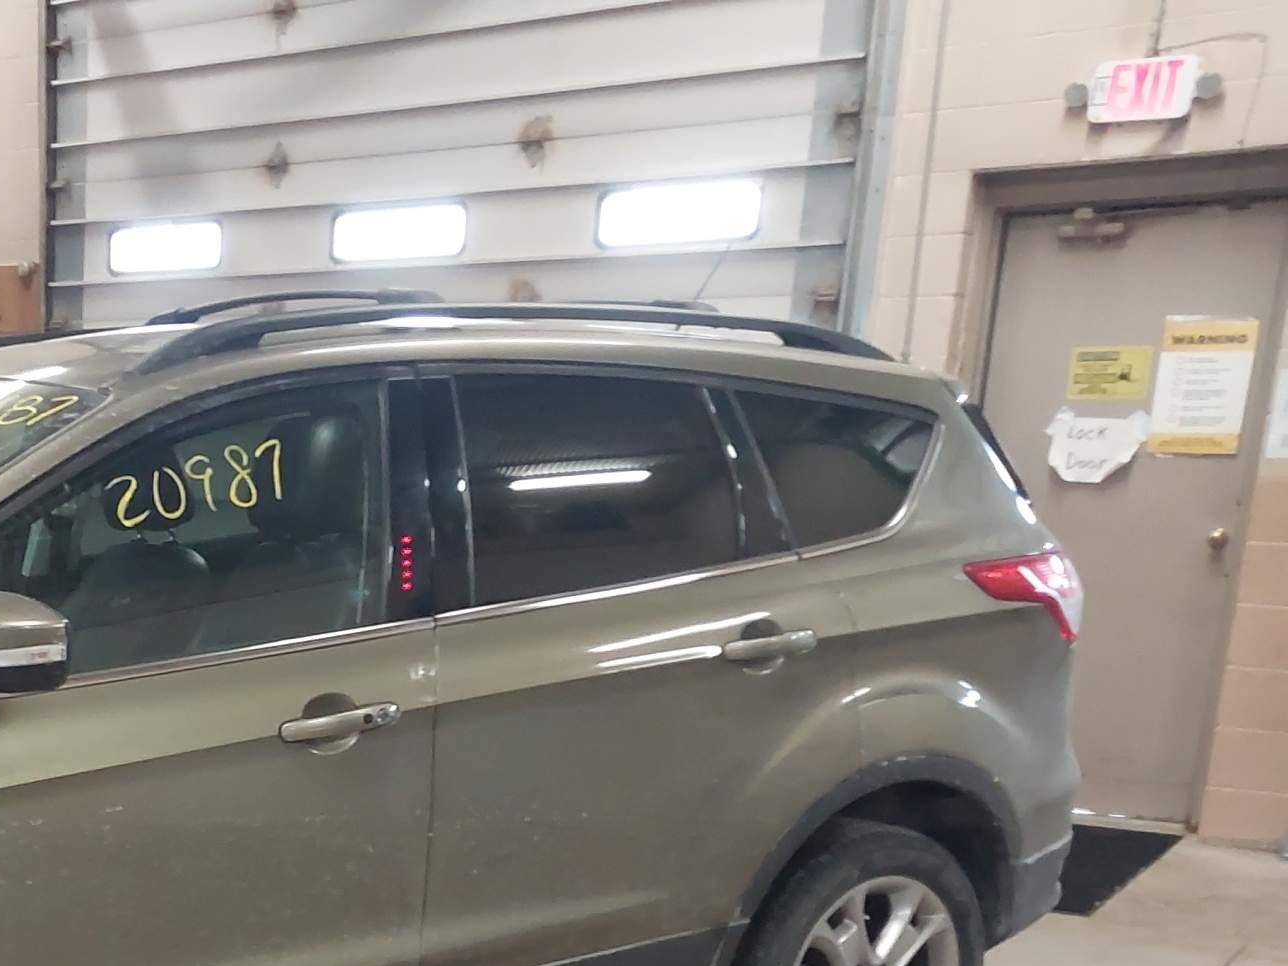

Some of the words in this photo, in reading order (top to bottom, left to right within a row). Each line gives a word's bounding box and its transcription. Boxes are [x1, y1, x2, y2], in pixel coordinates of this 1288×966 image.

[1107, 59, 1185, 114] EXIT
[1171, 333, 1249, 346] WARNING
[104, 438, 282, 528] 20987
